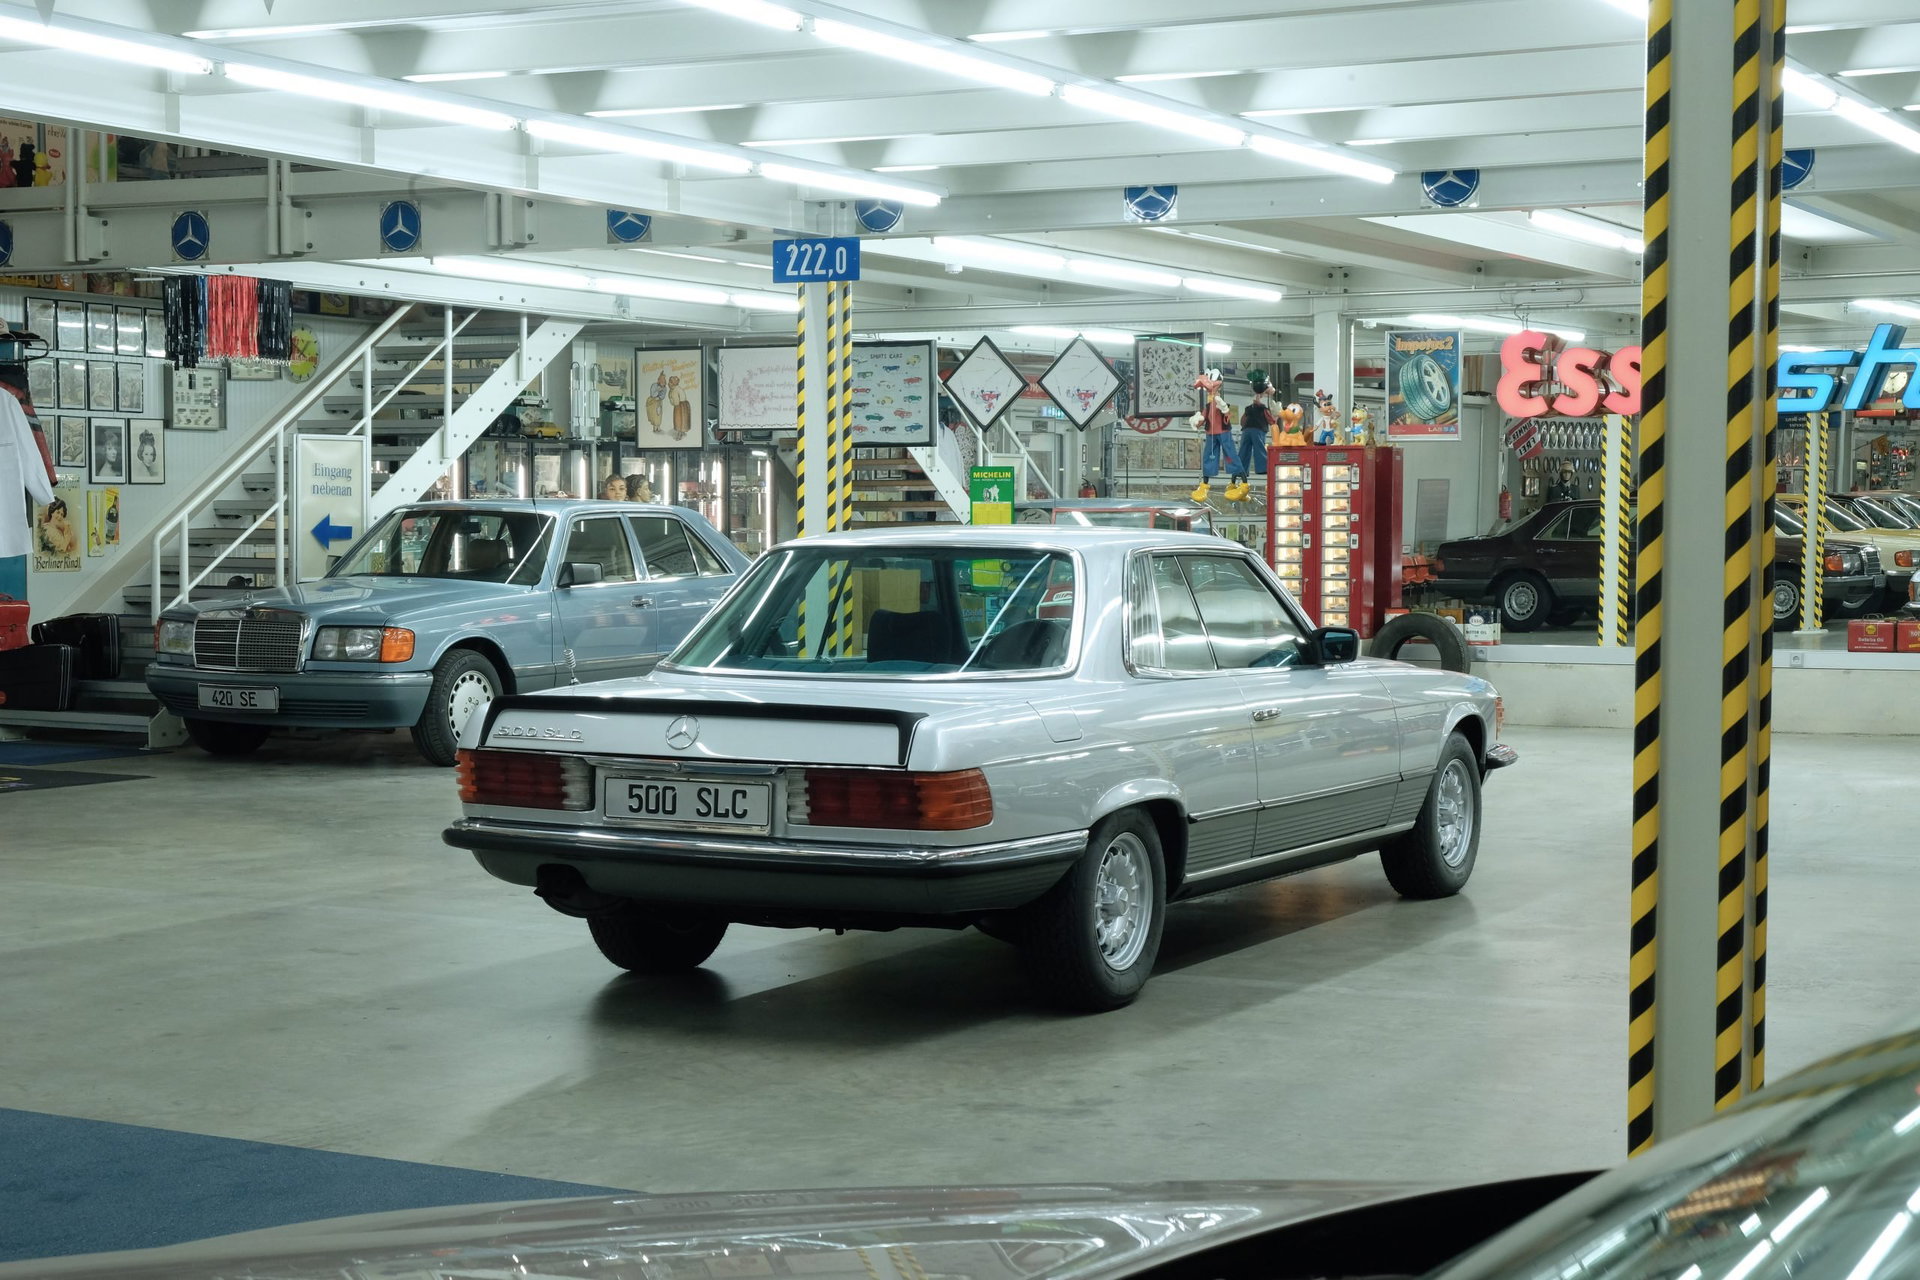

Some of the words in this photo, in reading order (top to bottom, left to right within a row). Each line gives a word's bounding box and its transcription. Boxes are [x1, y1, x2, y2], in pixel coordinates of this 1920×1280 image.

[786, 243, 846, 278] 222,0
[313, 463, 352, 481] Eingang
[312, 482, 352, 496] nebenan
[34, 556, 63, 570] Berliner
[64, 556, 81, 569] Kindl
[212, 690, 233, 706] 420
[240, 691, 257, 707] SE
[498, 726, 538, 737] 500
[628, 784, 677, 815] 500
[696, 787, 748, 819] SLC
